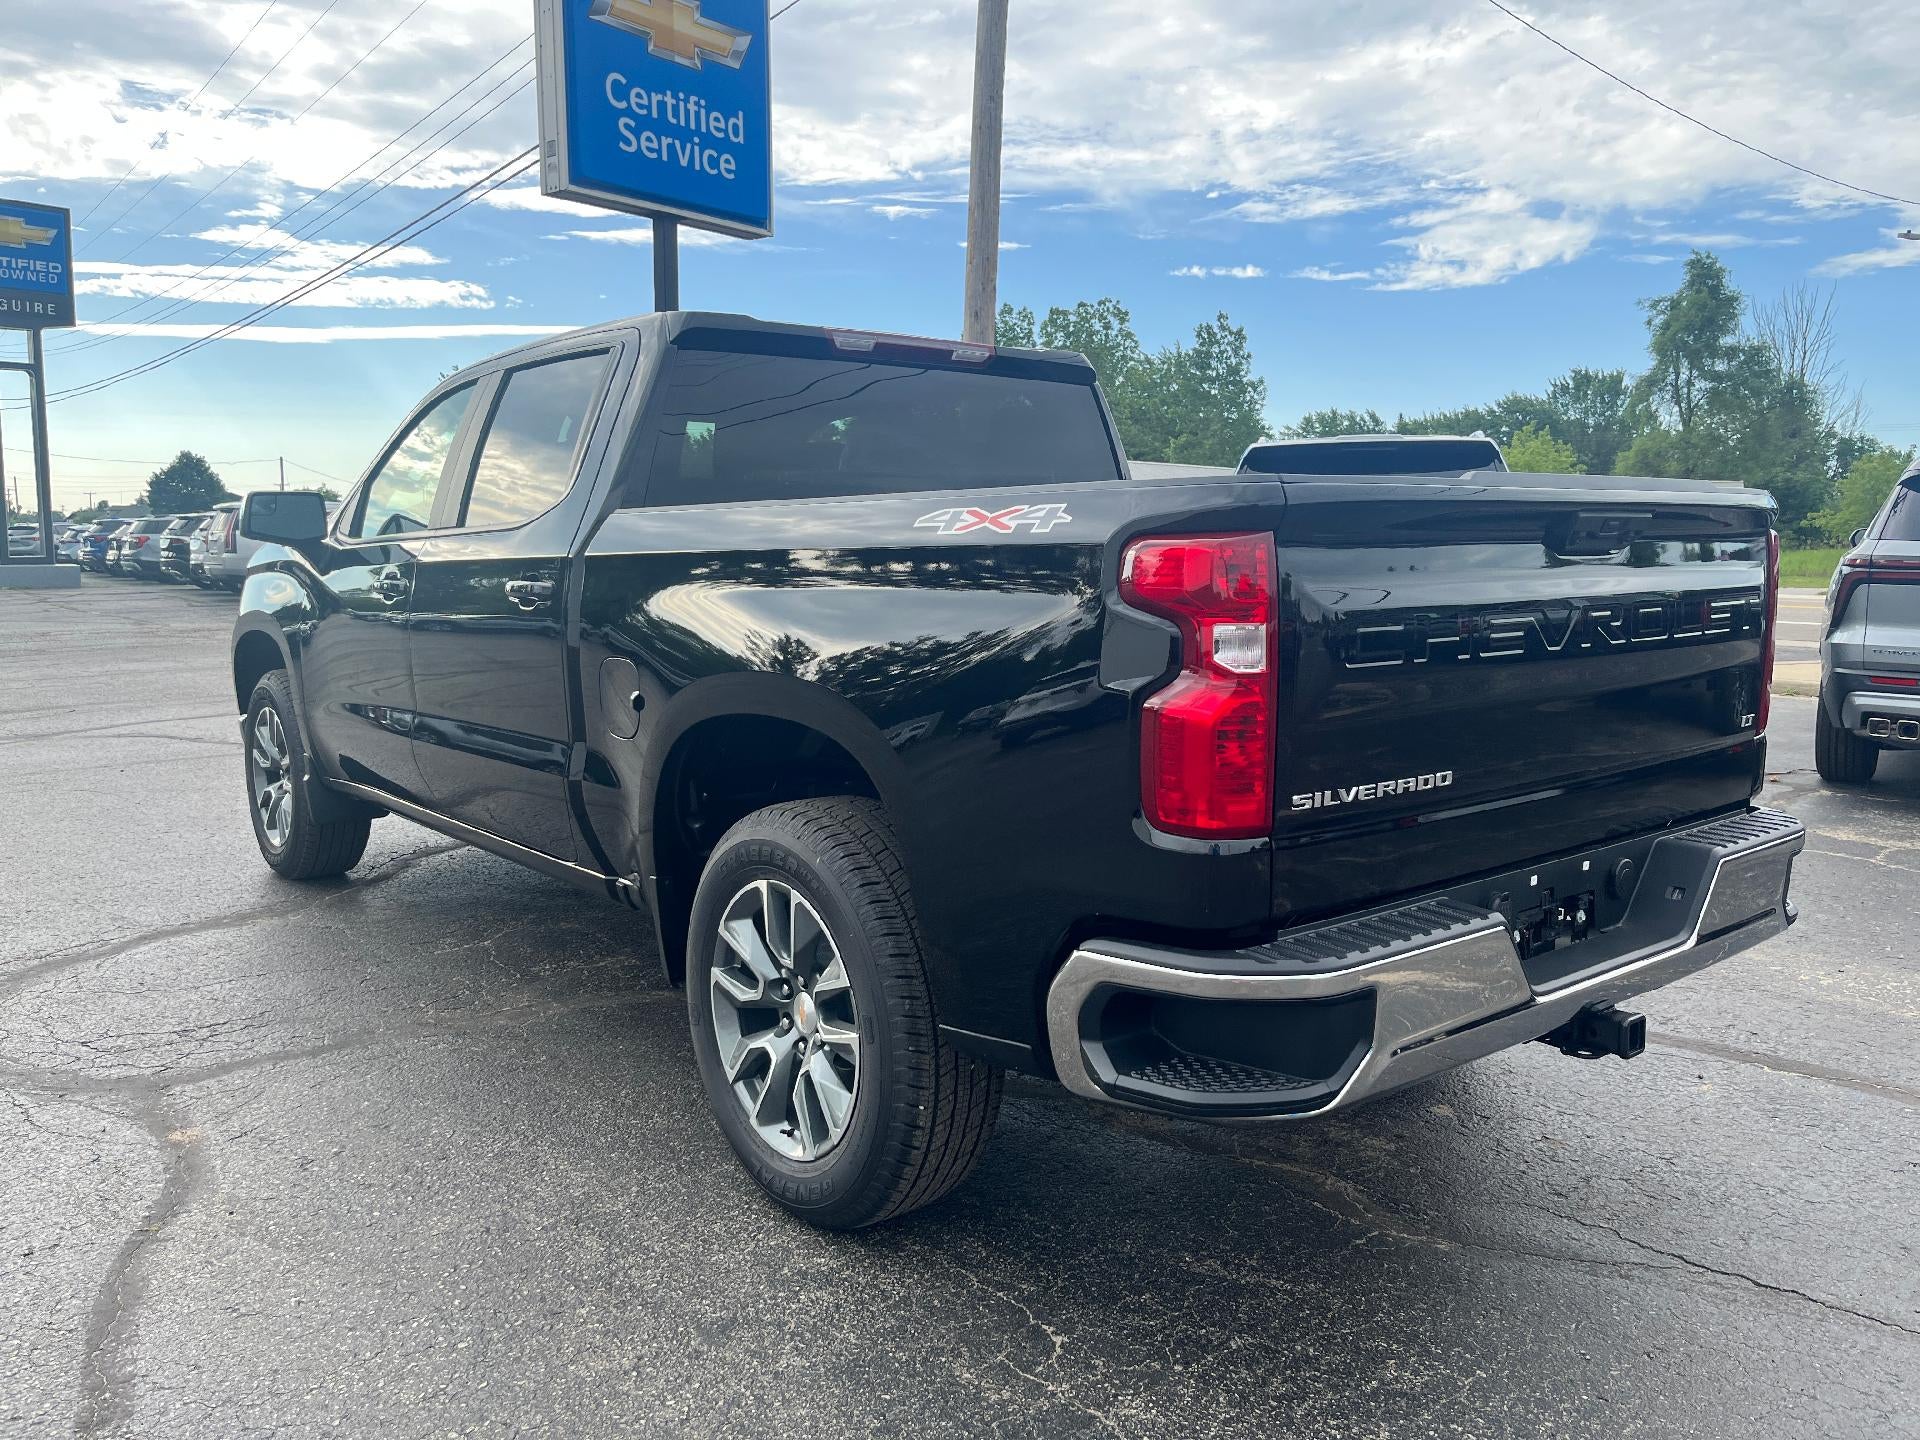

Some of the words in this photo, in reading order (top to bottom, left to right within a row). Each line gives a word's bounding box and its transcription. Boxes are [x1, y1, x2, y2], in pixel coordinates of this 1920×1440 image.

[605, 72, 745, 145] Certified
[618, 117, 737, 180] Service
[0, 256, 62, 273] TIFIED
[0, 268, 58, 284] OWNED
[0, 298, 56, 315] GUIRE
[1341, 594, 1759, 668] CHEVROLET
[1291, 770, 1454, 811] SILVERADO
